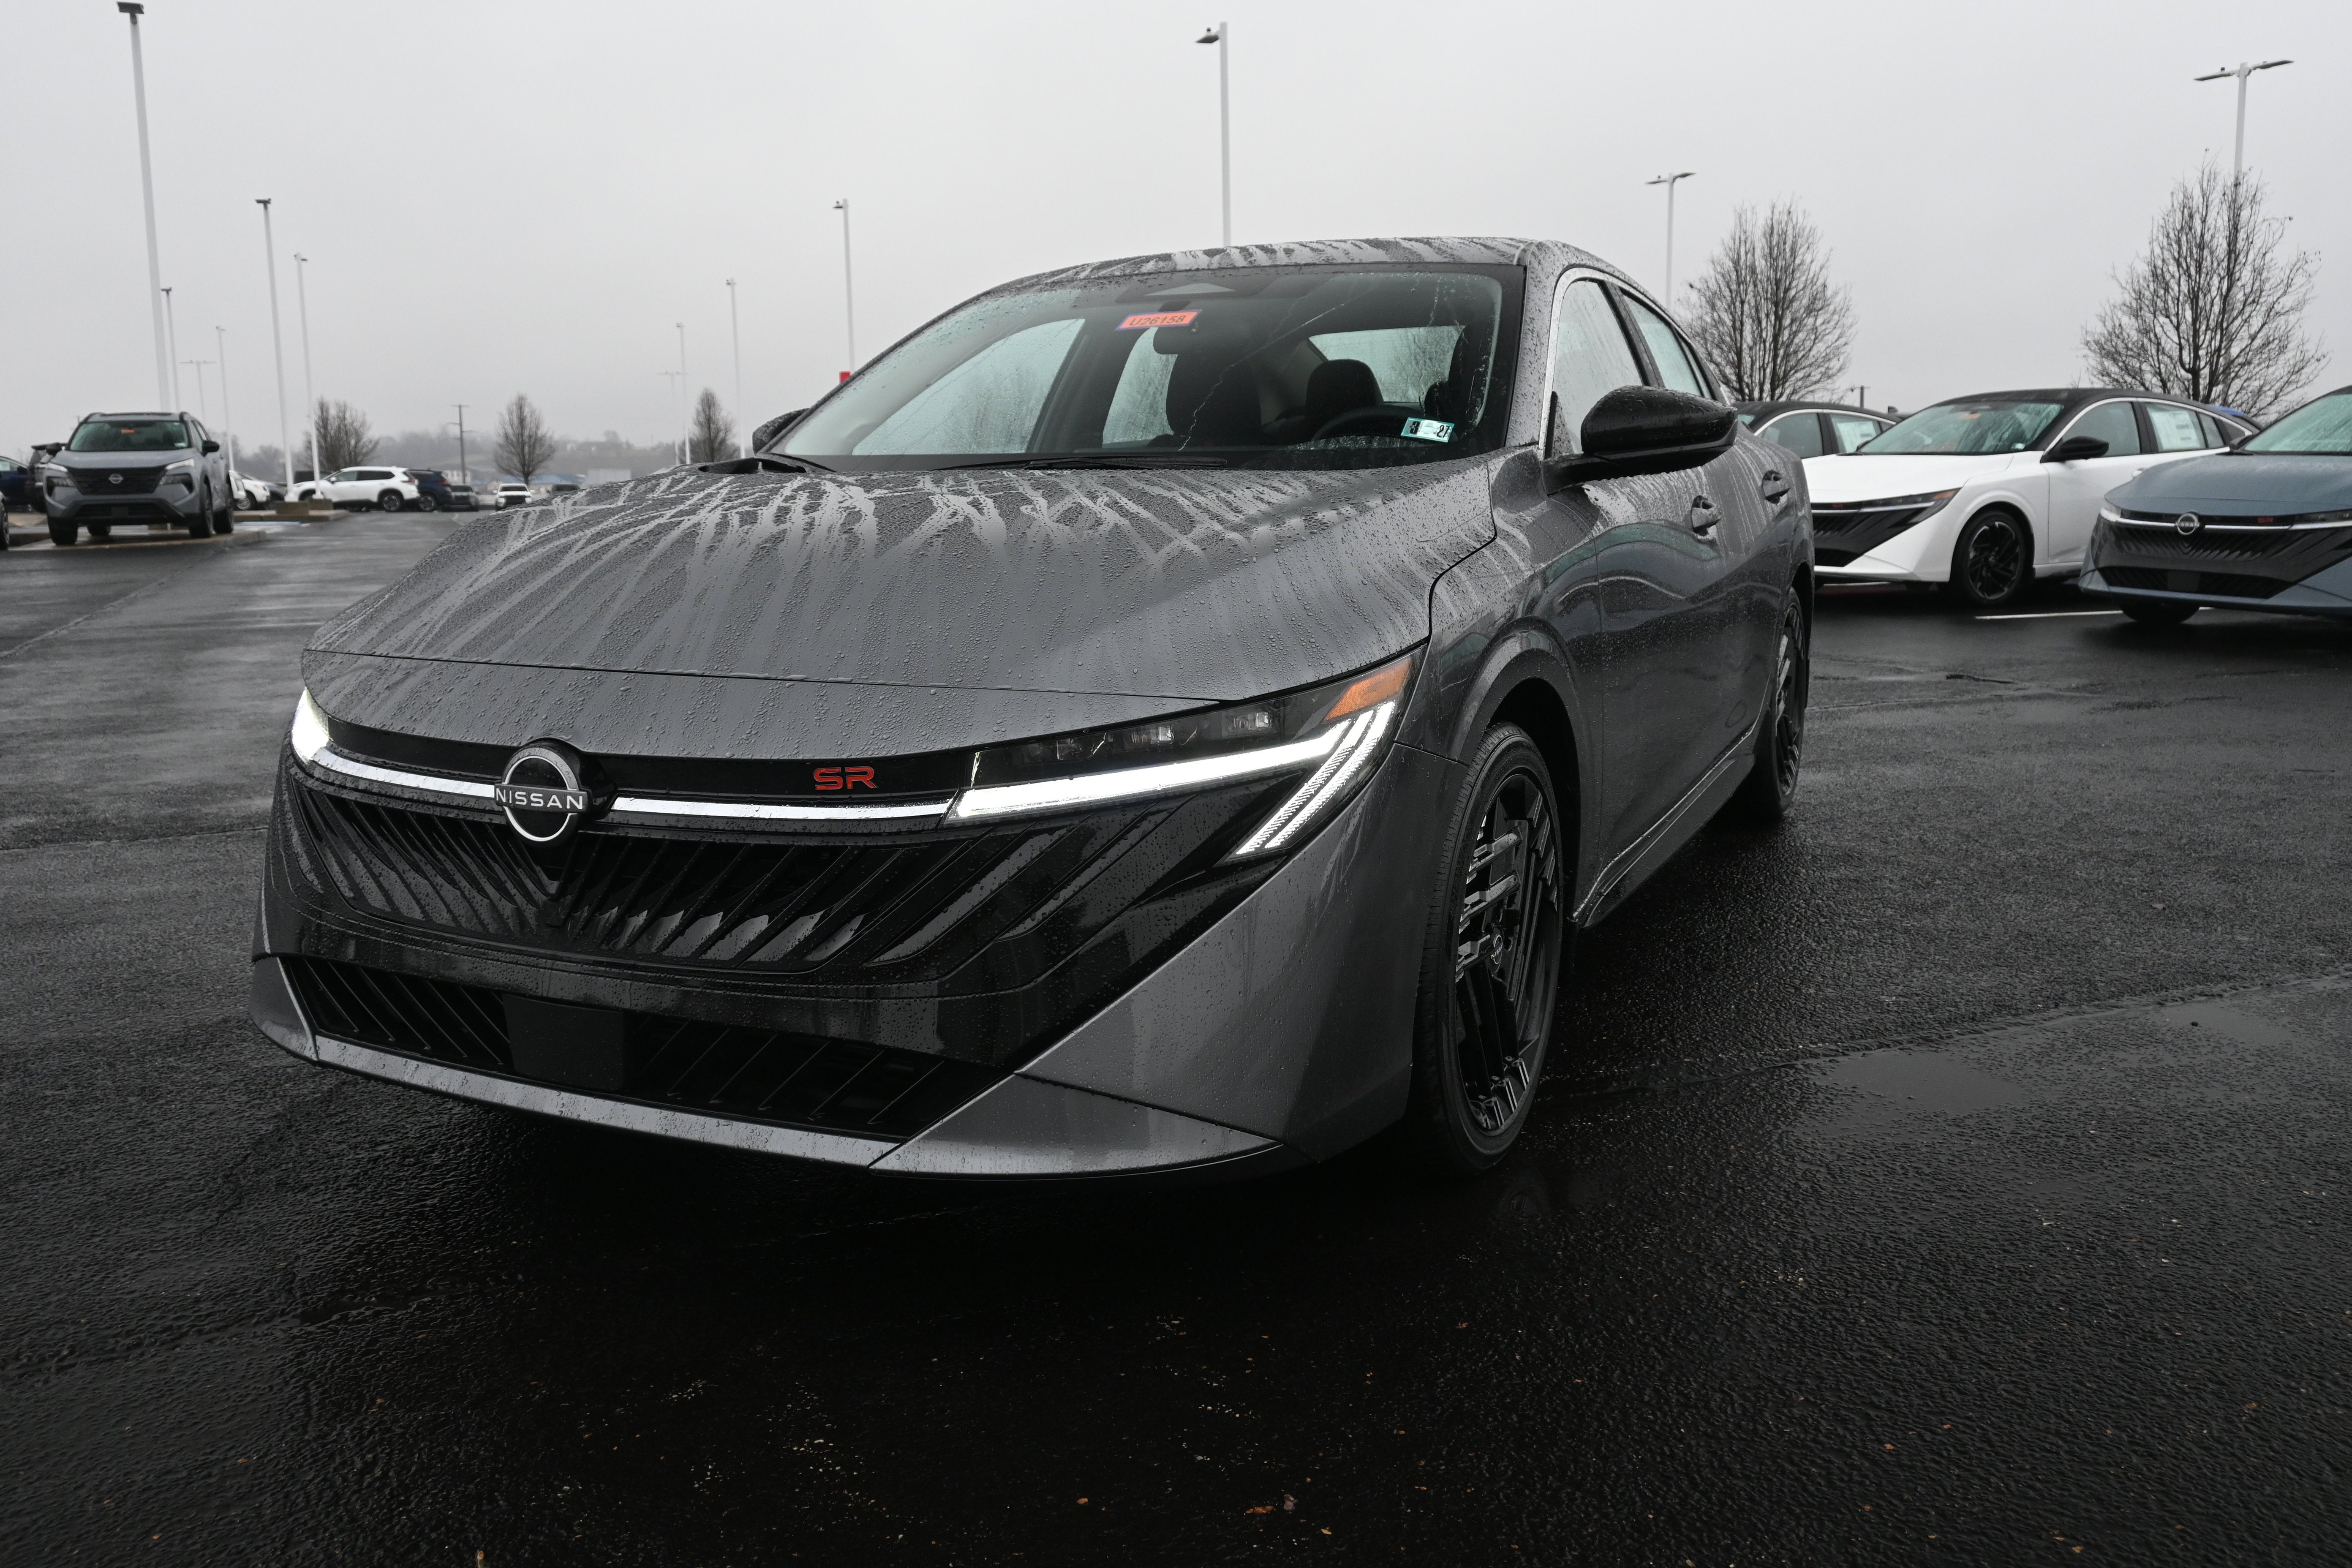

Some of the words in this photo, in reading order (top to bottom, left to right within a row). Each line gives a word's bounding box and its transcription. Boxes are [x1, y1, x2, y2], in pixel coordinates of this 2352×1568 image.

[1130, 315, 1186, 327] U26158
[1410, 421, 1420, 434] 3
[1436, 425, 1450, 438] 27
[813, 766, 878, 790] SR
[496, 788, 583, 809] NISSAN
